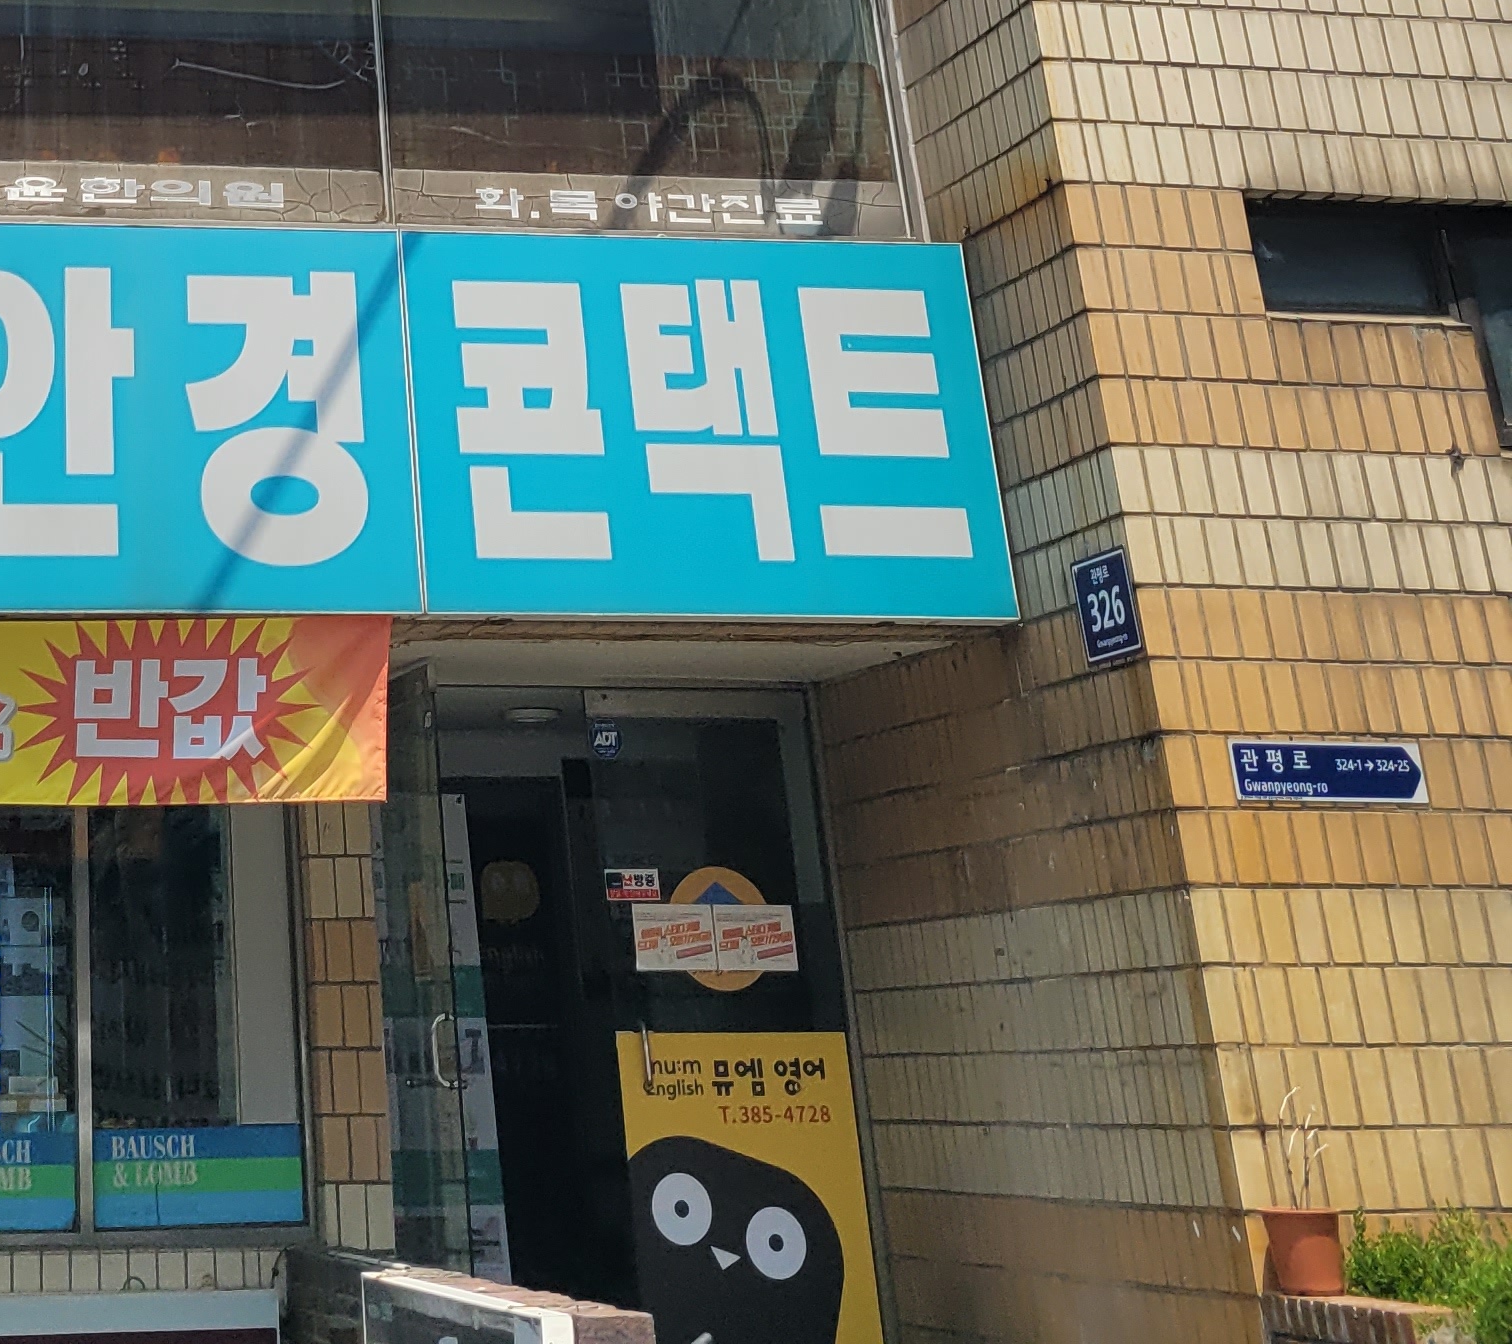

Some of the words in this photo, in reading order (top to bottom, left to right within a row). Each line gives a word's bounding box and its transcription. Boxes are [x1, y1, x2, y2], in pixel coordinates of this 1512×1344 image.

[451, 278, 974, 564] 콘택트
[1087, 585, 1126, 633] 326
[74, 658, 268, 760] 반값
[593, 731, 617, 746] ADT
[1335, 758, 1362, 772] 324-1
[1376, 758, 1410, 773] 324-25
[1244, 778, 1328, 796] Gwanpyeong-ro
[712, 1057, 764, 1097] 뮤엠
[773, 1057, 826, 1096] 영어
[718, 1105, 832, 1126] T.385-4728
[111, 1135, 197, 1160] BAUSCH
[112, 1164, 129, 1188] &
[135, 1162, 199, 1187] LOMB
